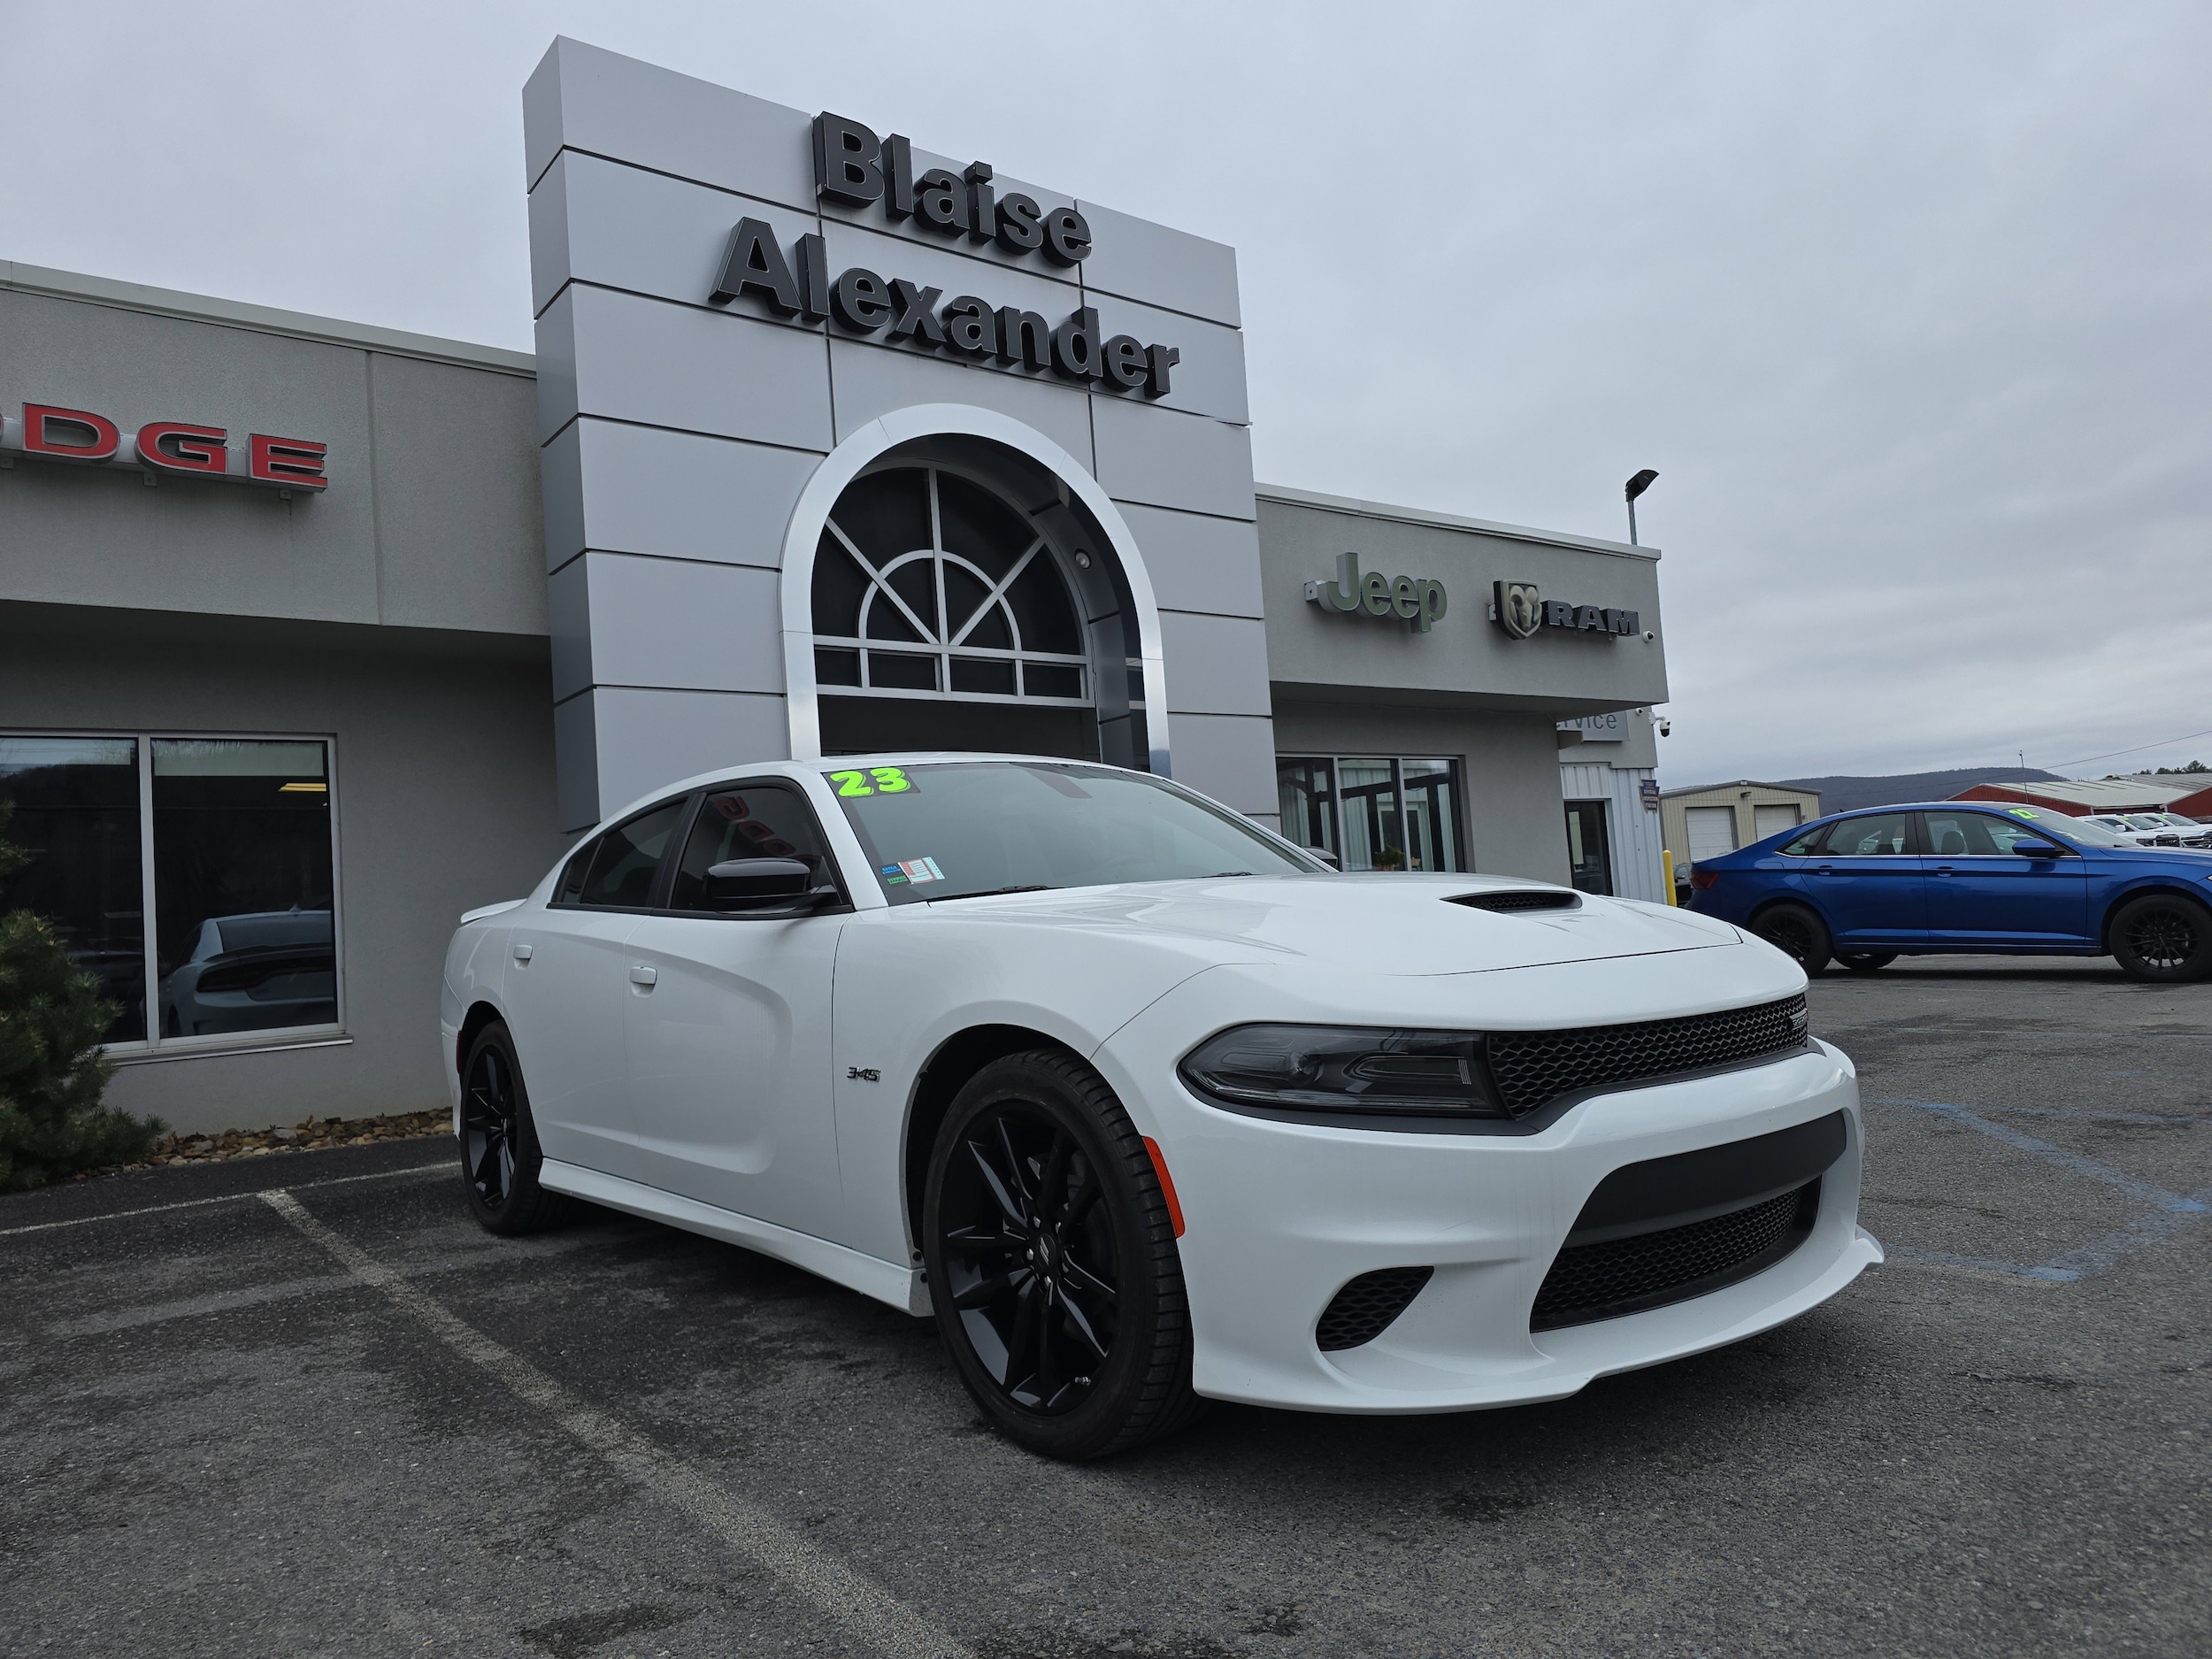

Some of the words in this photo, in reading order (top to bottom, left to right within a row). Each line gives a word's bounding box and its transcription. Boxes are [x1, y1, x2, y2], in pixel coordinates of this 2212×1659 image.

[812, 111, 1093, 266] Blaise
[709, 217, 1180, 399] Alexander
[0, 403, 328, 493] DGE
[1317, 552, 1448, 634] Jeep
[1540, 600, 1640, 636] RAM
[830, 767, 911, 797] 23
[847, 1067, 881, 1082] 345
